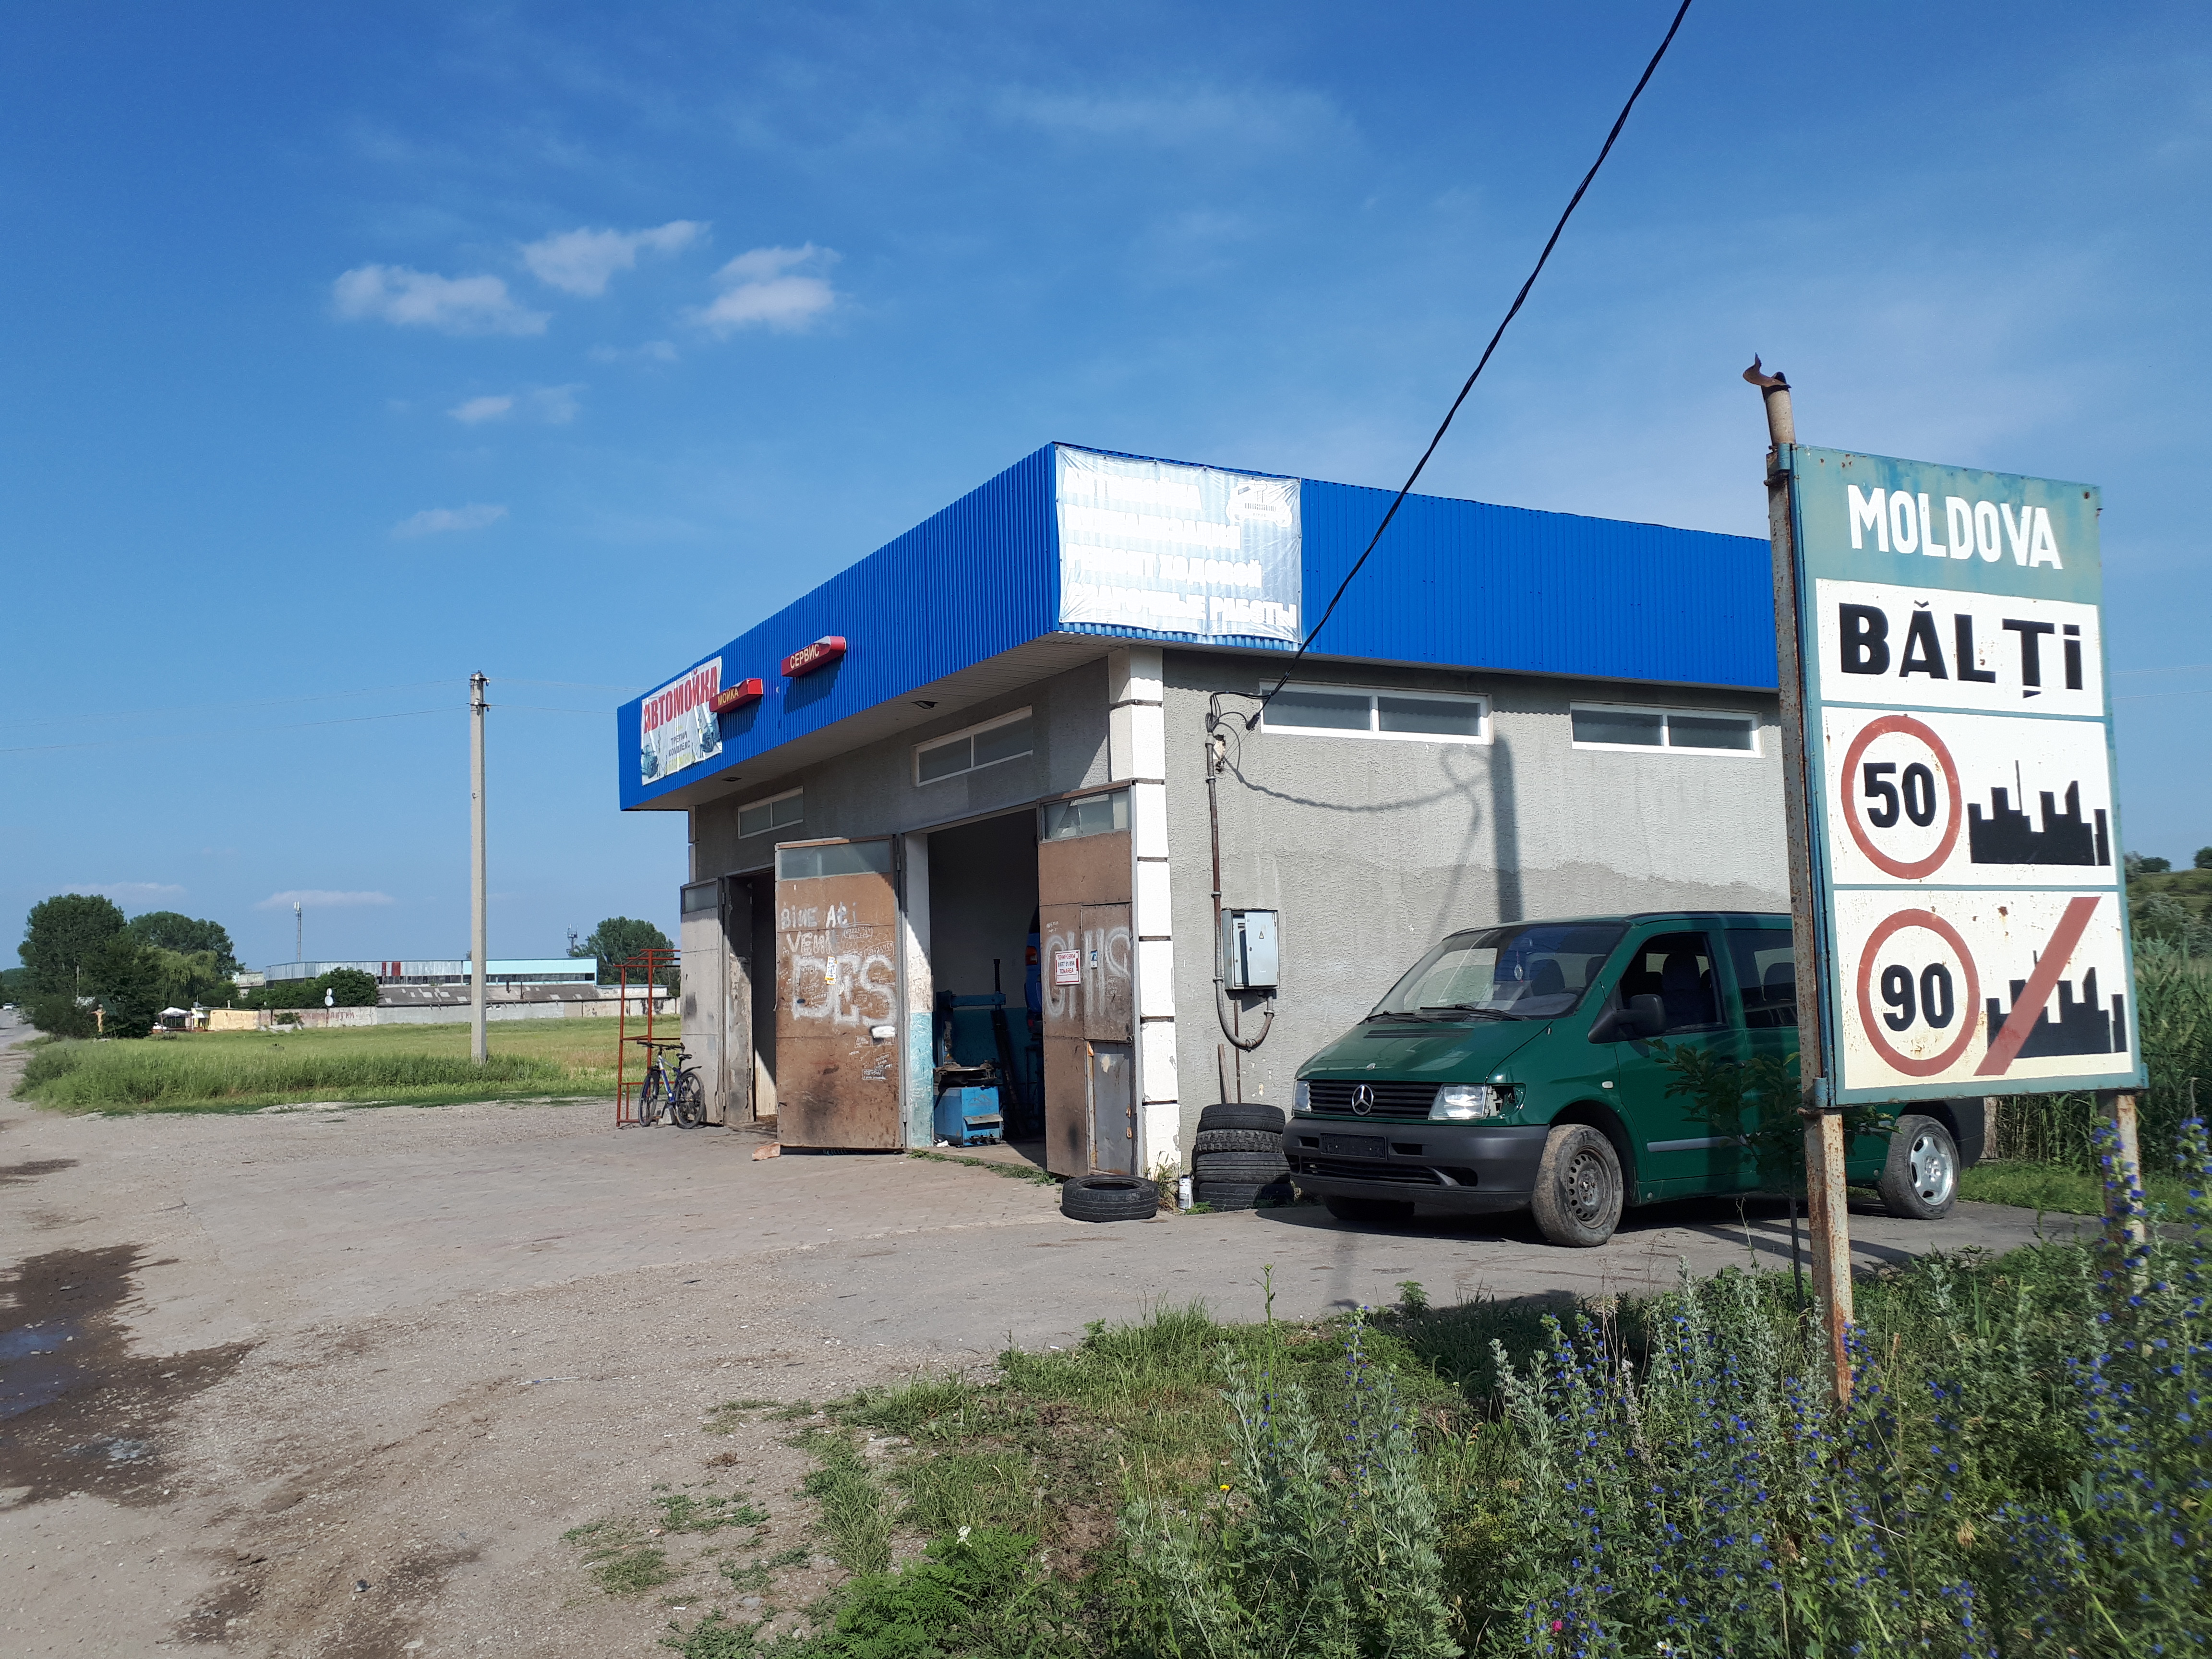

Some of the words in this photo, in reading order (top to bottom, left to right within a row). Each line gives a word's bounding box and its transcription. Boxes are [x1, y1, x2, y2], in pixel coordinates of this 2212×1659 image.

[1847, 484, 2064, 570] MOLDOVA
[1158, 553, 1262, 588] ХОДОВОЙ
[1209, 596, 1298, 629] РАБОТЫ
[790, 643, 819, 669] СЕРВИС
[644, 665, 718, 734] АВТОМОЙКА
[718, 687, 739, 707] МОЙКА
[1863, 761, 1937, 828] 50
[1880, 962, 1954, 1032] 90
